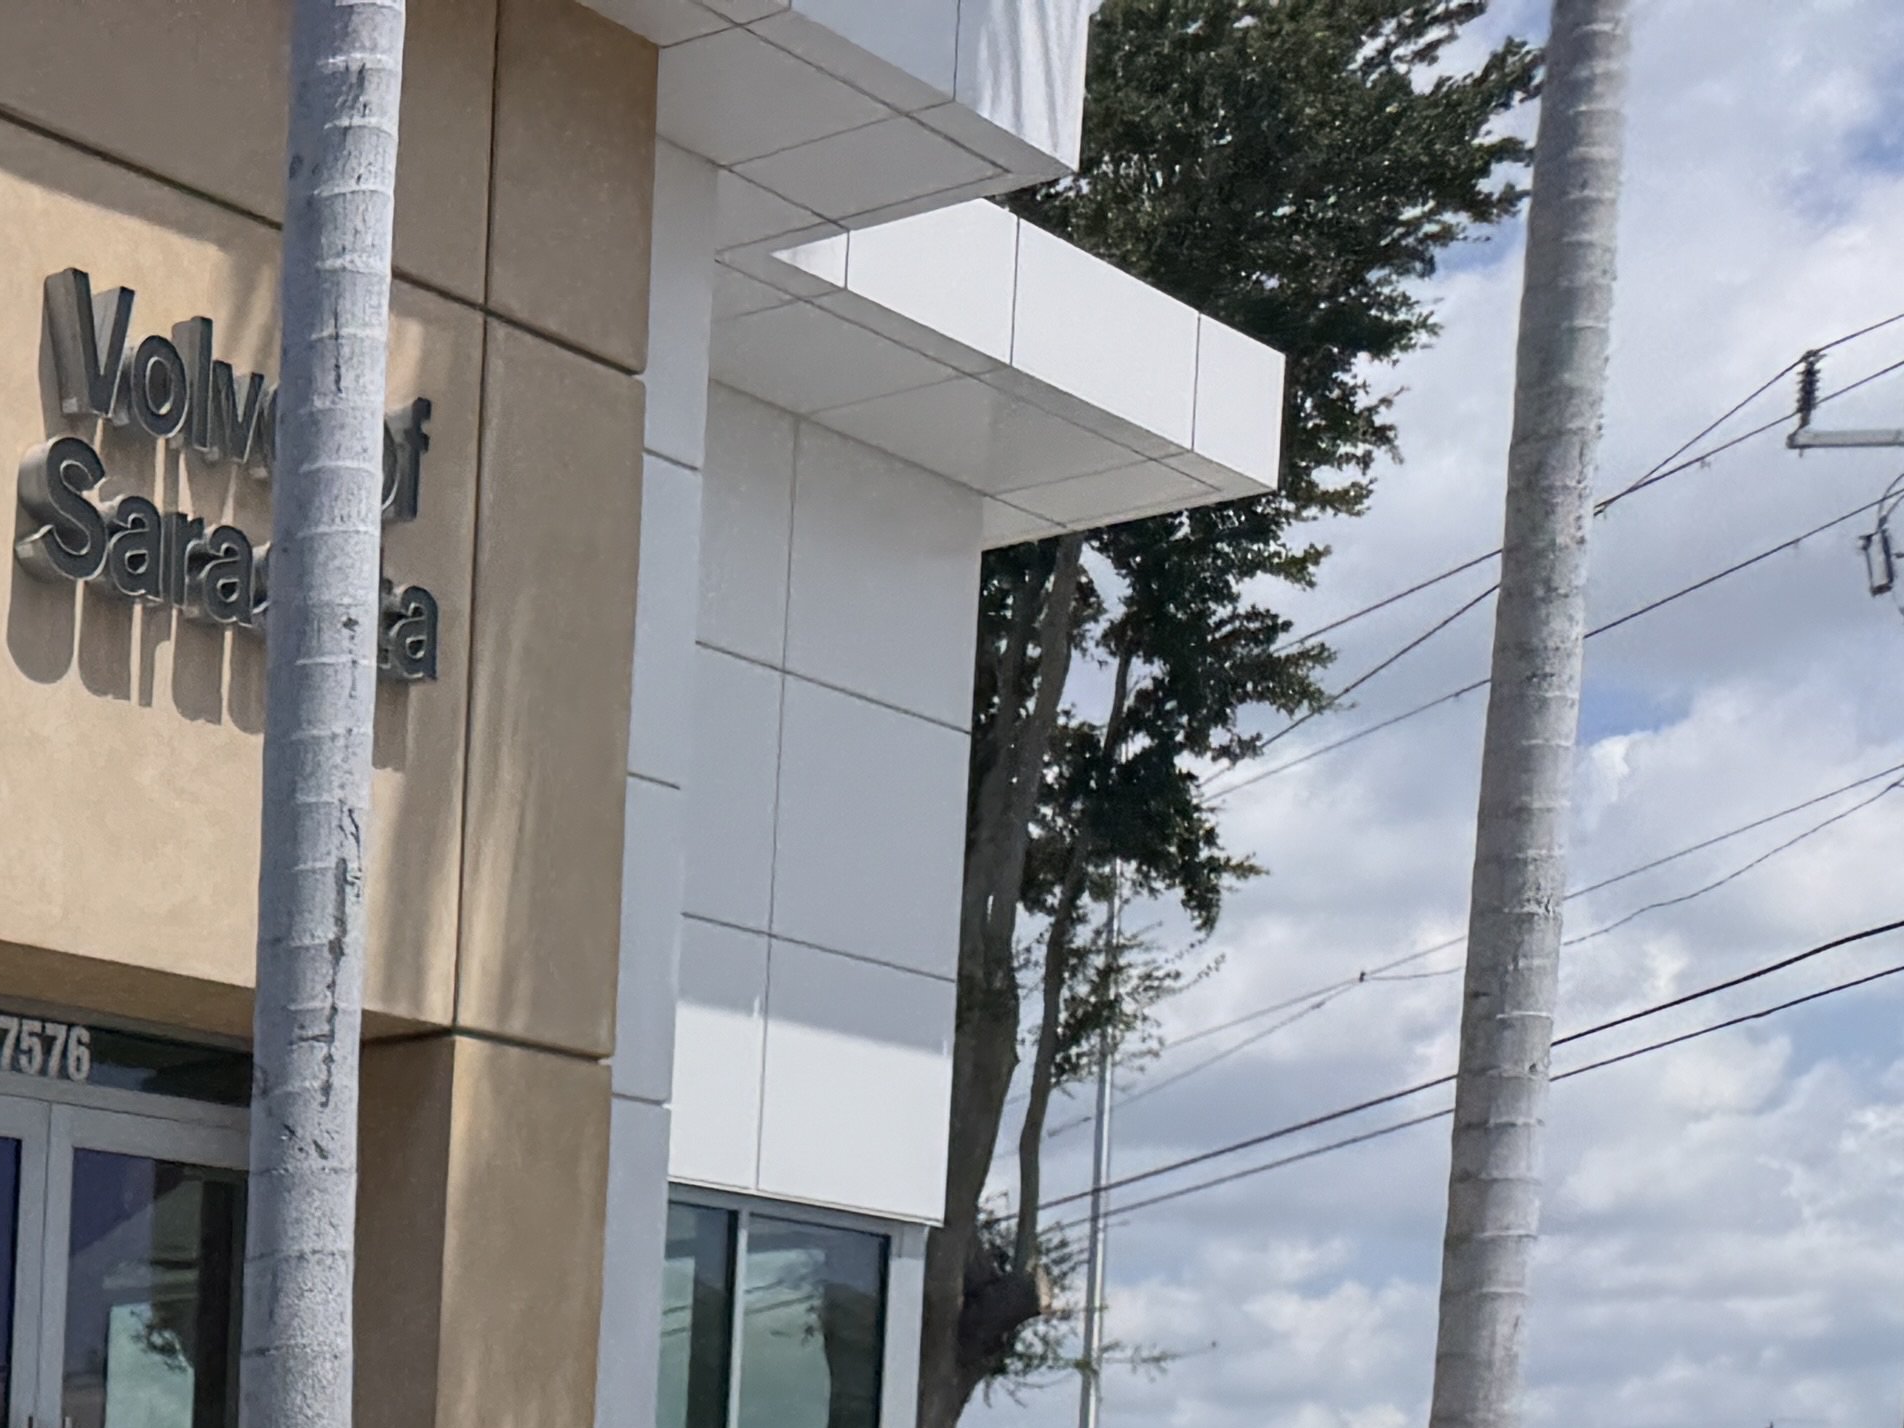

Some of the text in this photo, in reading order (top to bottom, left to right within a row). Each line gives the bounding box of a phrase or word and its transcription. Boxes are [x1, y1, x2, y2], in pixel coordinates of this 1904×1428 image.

[43, 267, 432, 522] Volv f
[16, 436, 438, 683] Saraa
